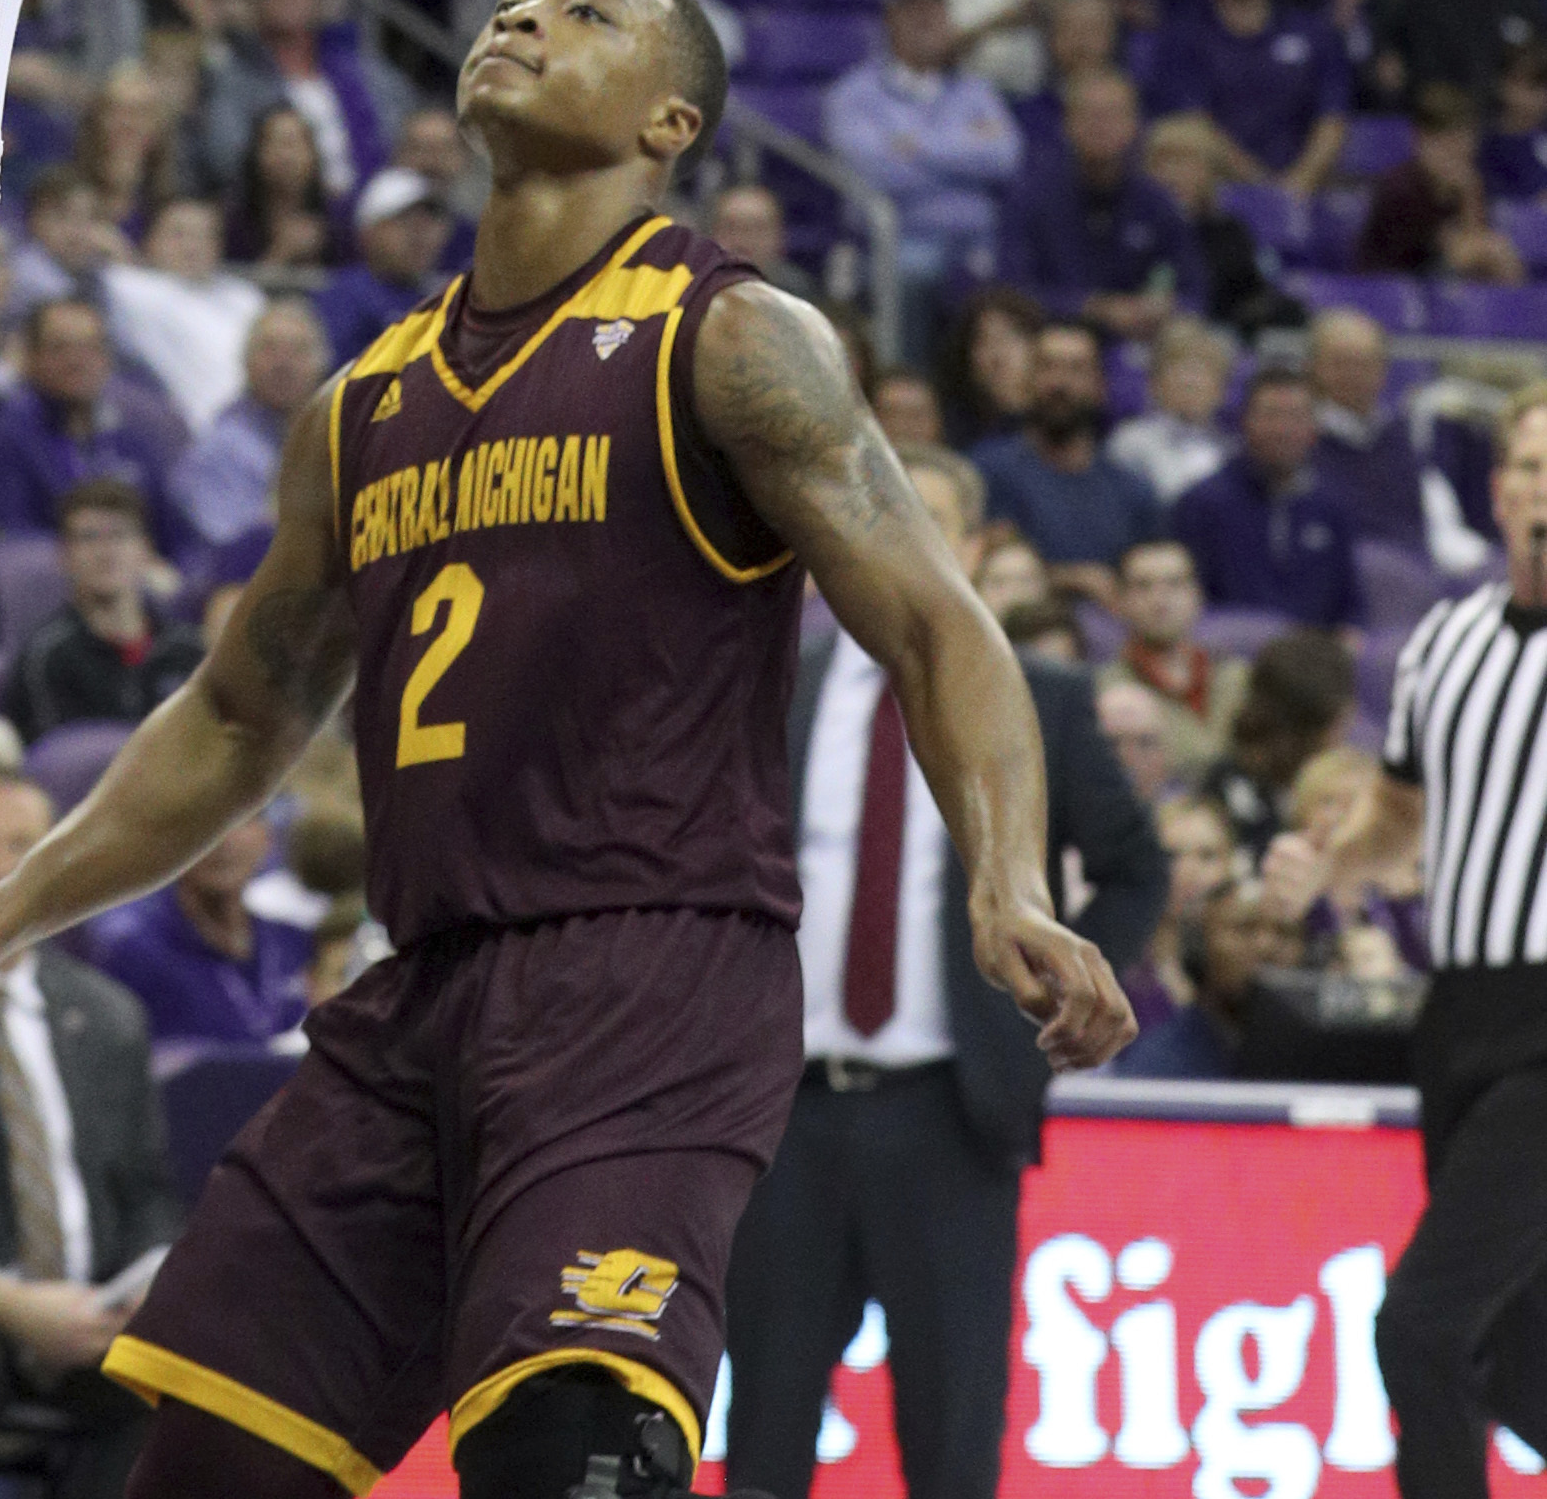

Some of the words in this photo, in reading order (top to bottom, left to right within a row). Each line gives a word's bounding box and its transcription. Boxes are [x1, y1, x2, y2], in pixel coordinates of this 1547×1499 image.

[351, 456, 451, 573] CENTRAL
[454, 434, 611, 533] MICHIGAN
[395, 562, 485, 770] 2
[1023, 1233, 1547, 1499] fig
